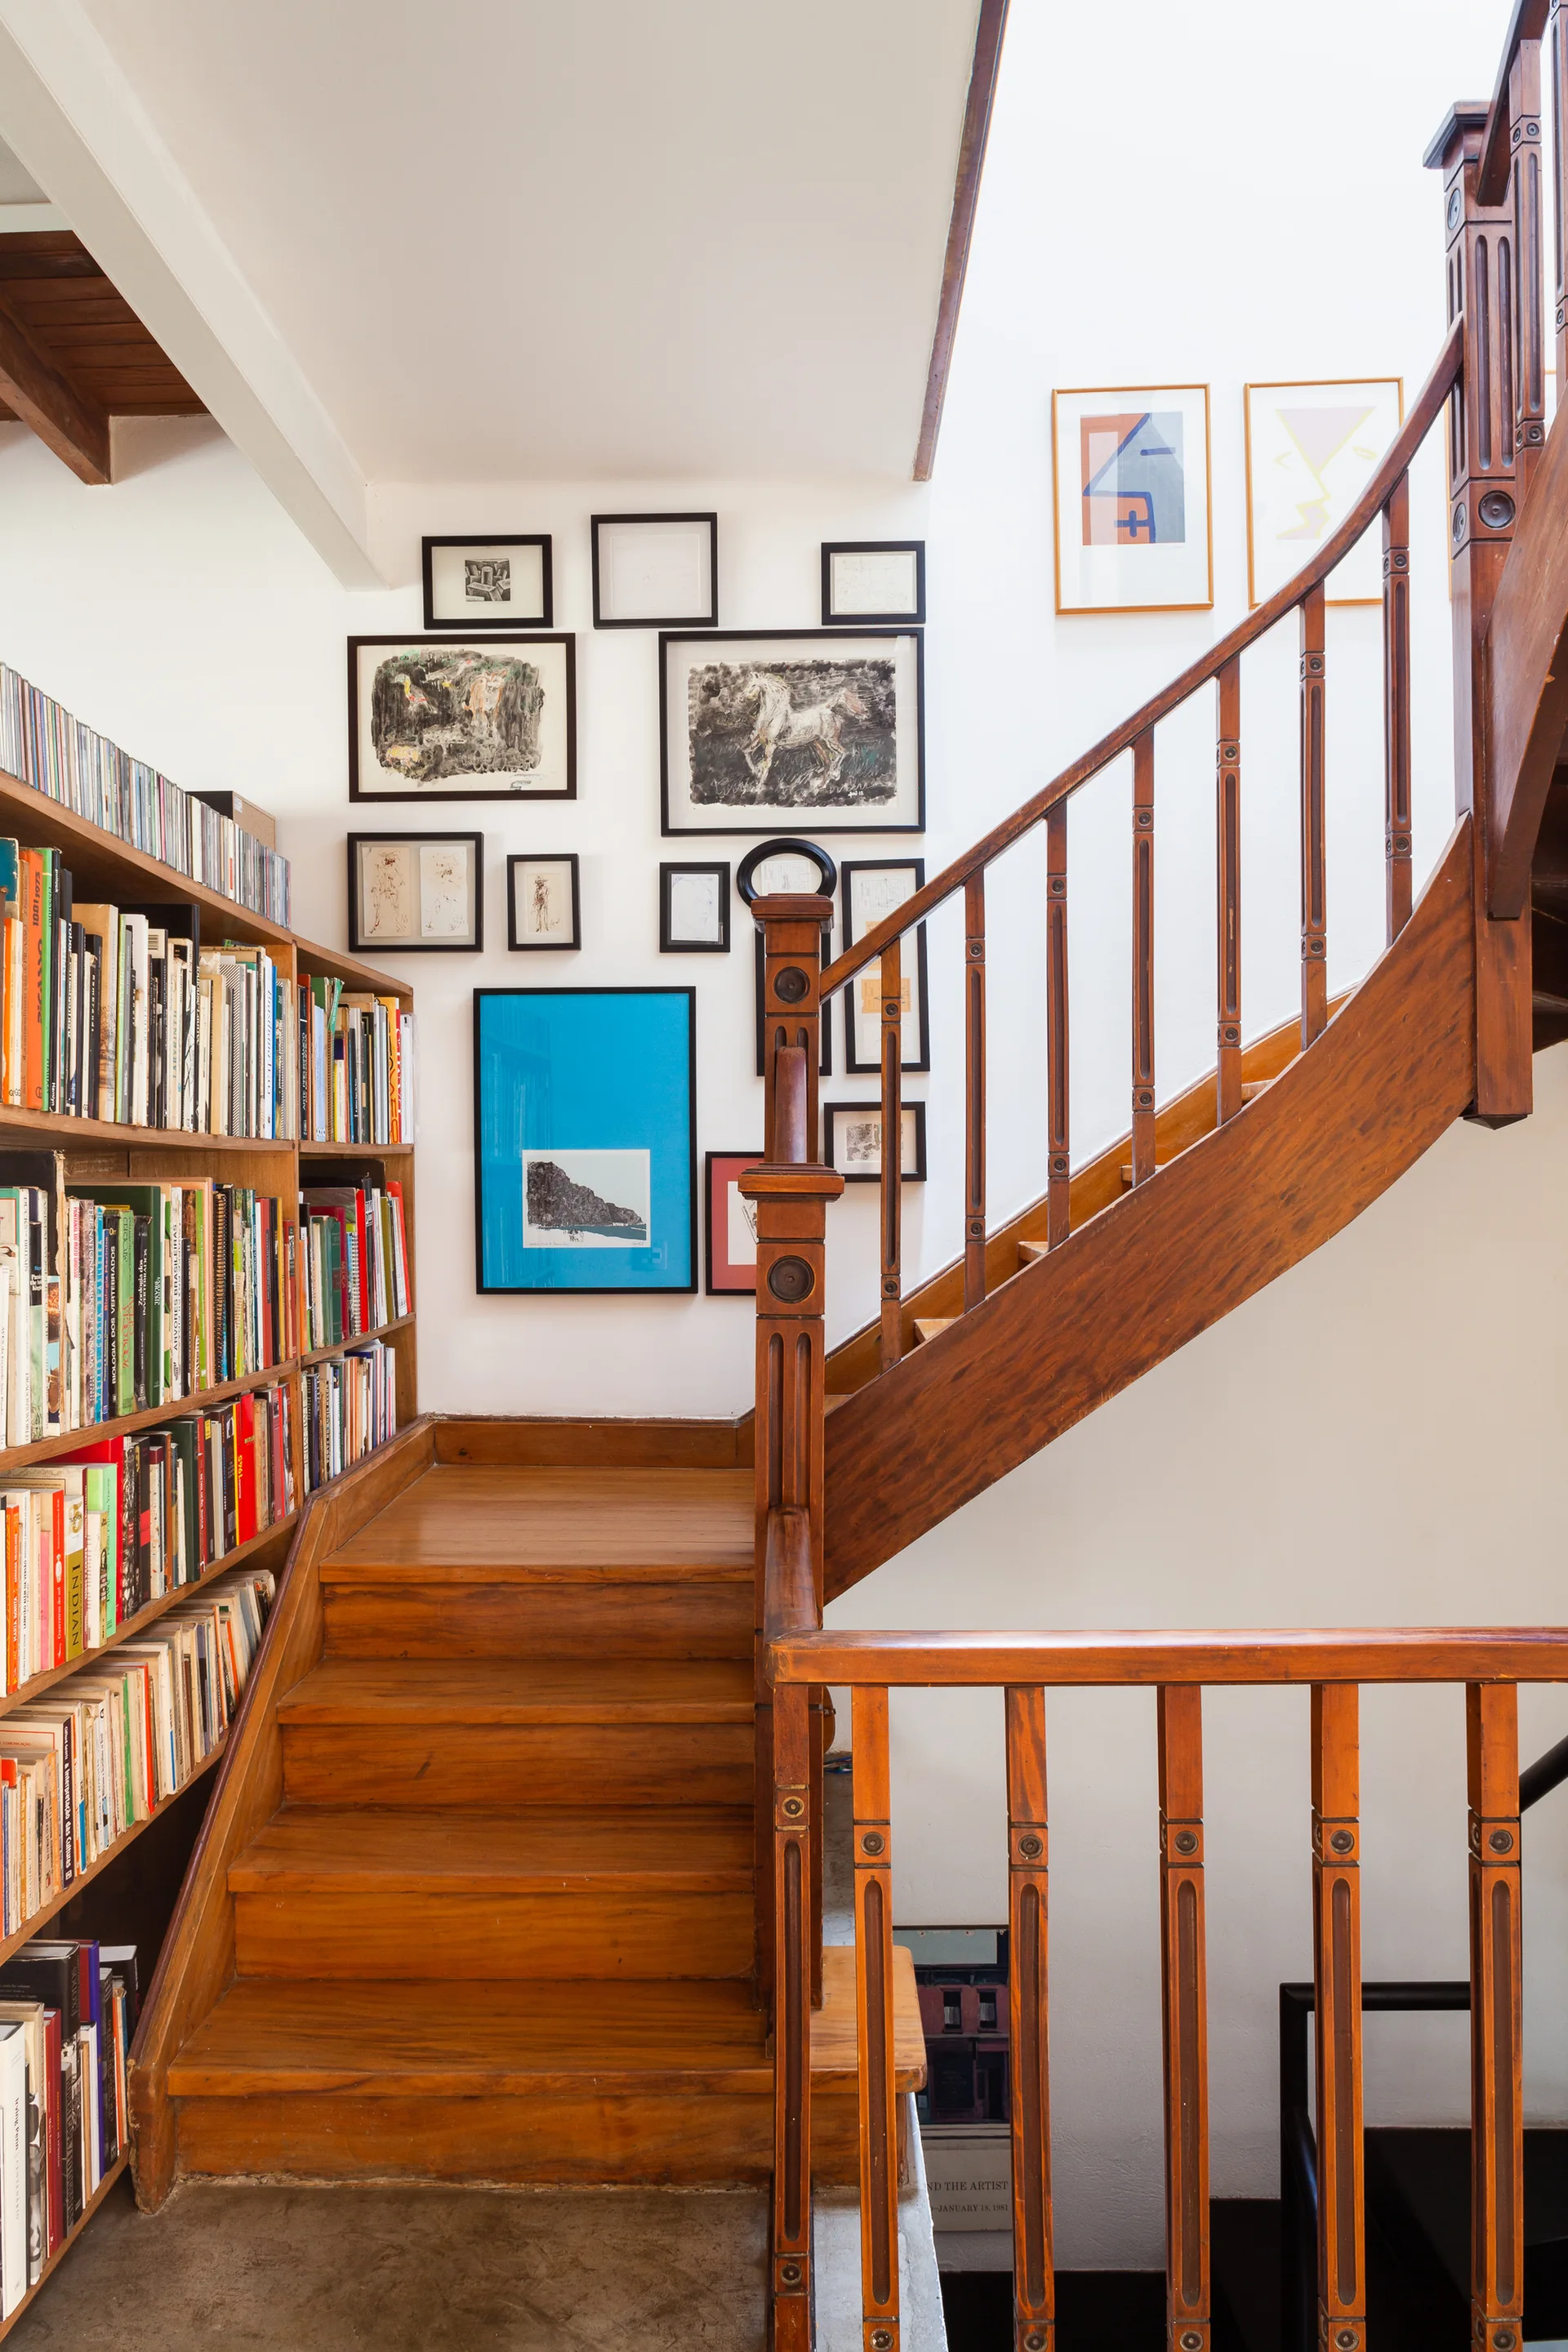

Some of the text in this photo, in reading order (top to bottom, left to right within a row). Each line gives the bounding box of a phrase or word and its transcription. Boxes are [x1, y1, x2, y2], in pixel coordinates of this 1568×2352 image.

[72, 1563, 81, 1646] INDIAN
[927, 2180, 1009, 2191] ND THE ARTIST
[981, 2204, 991, 2212] 18,
